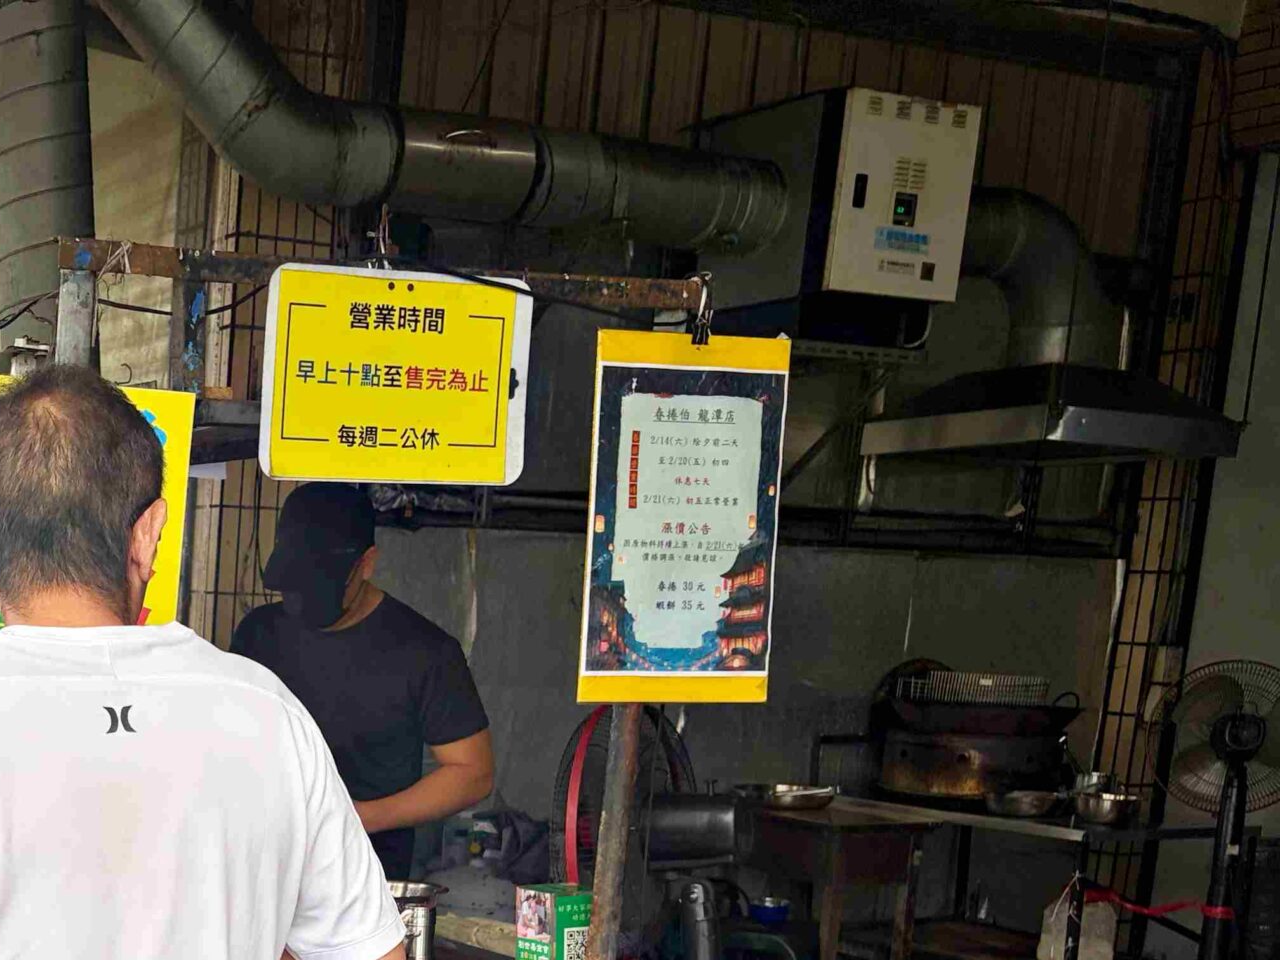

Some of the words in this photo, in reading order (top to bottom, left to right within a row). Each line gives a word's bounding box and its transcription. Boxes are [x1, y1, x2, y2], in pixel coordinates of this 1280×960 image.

[349, 302, 445, 334] 營業時間
[296, 360, 488, 393] 早上十點至售完為止
[654, 407, 690, 421] 春捲伯
[698, 409, 736, 423] 龍潭店
[337, 424, 440, 450] 每週二公休
[674, 476, 711, 486] 休息七天
[658, 581, 677, 592] 春捲
[682, 581, 694, 592] 30
[696, 582, 706, 592] 元
[681, 600, 693, 611] 35
[696, 602, 705, 611] 元
